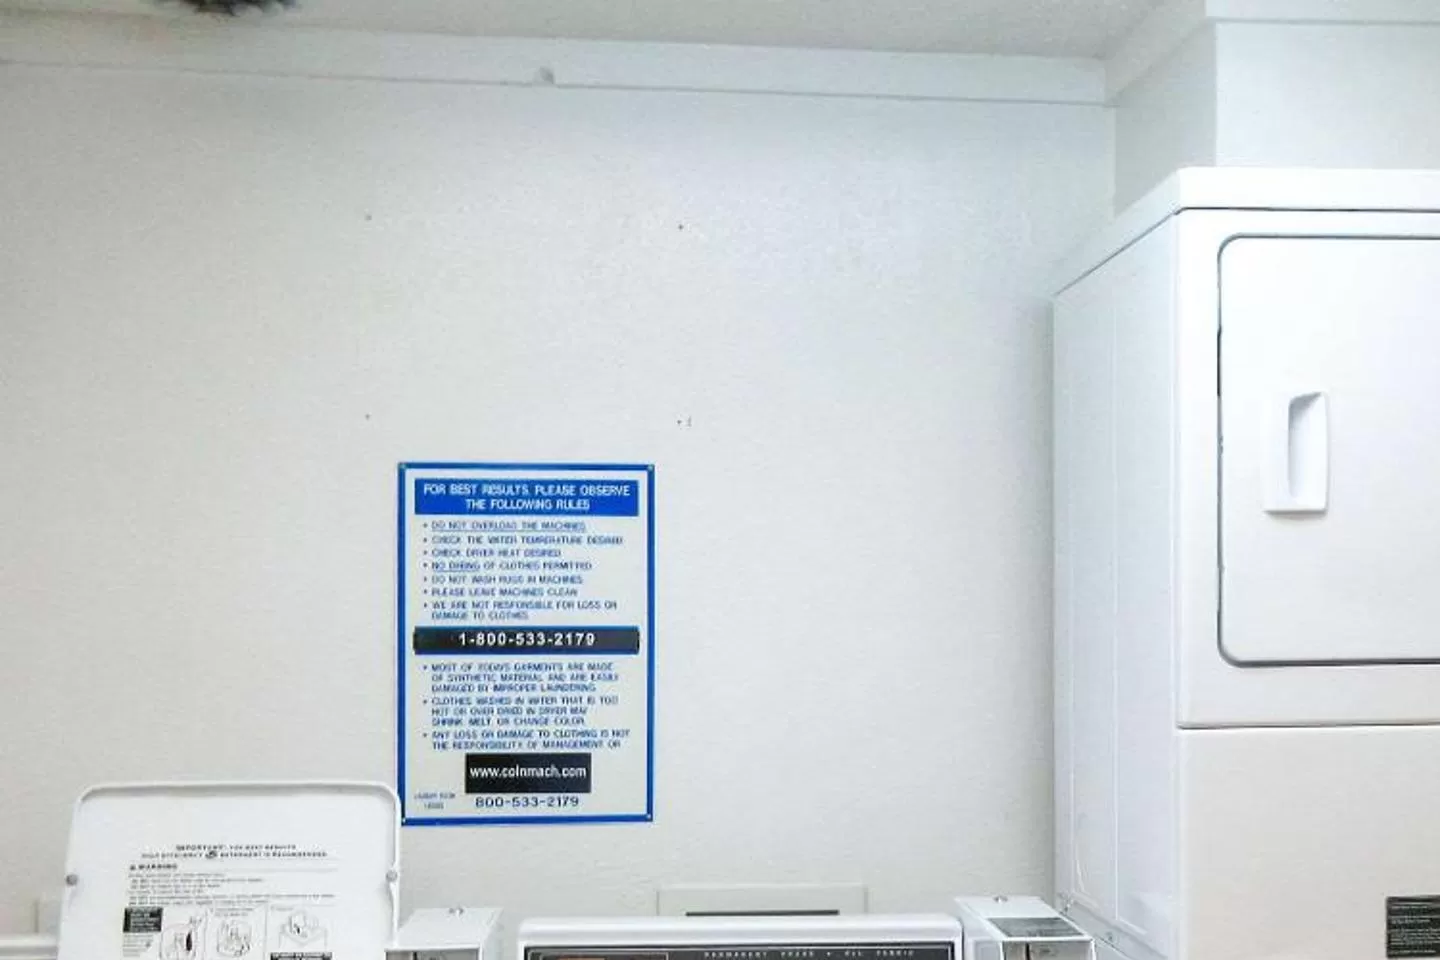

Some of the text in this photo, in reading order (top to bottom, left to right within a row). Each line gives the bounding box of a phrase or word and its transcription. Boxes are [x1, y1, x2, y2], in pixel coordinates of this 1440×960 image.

[424, 483, 446, 496] FOR
[449, 483, 477, 496] BEST
[535, 483, 576, 496] PLEASE
[580, 483, 631, 496] OBSERVE
[466, 498, 590, 510] THE FOLLOWING RULES
[431, 588, 578, 596] PLEASE LEAVE MACHINES CLEAN
[433, 601, 617, 609] WE ARE NOT RESPONSIBLE FOR LOSS OR
[459, 631, 595, 646] 1-800-533-2179
[475, 796, 580, 808] 800-533-2179
